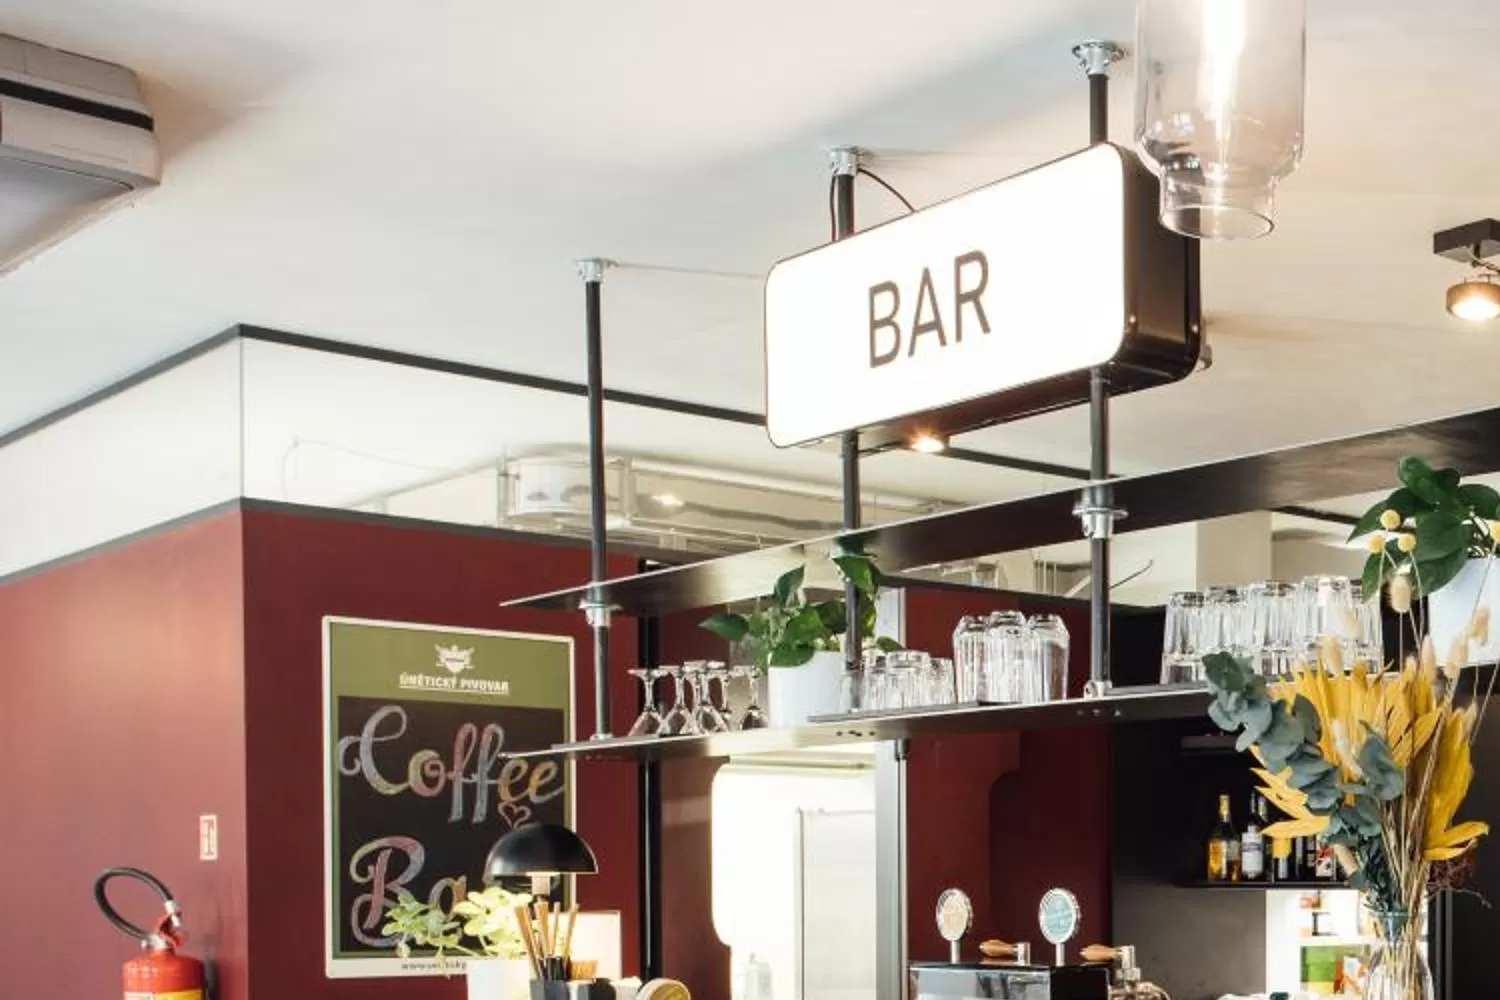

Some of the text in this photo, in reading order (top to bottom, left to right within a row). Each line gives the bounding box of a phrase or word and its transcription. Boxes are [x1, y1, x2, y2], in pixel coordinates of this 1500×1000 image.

[868, 249, 991, 369] BAR
[459, 678, 509, 694] PIVOVAR
[338, 704, 566, 824] Coffee
[350, 836, 490, 948] Ba
